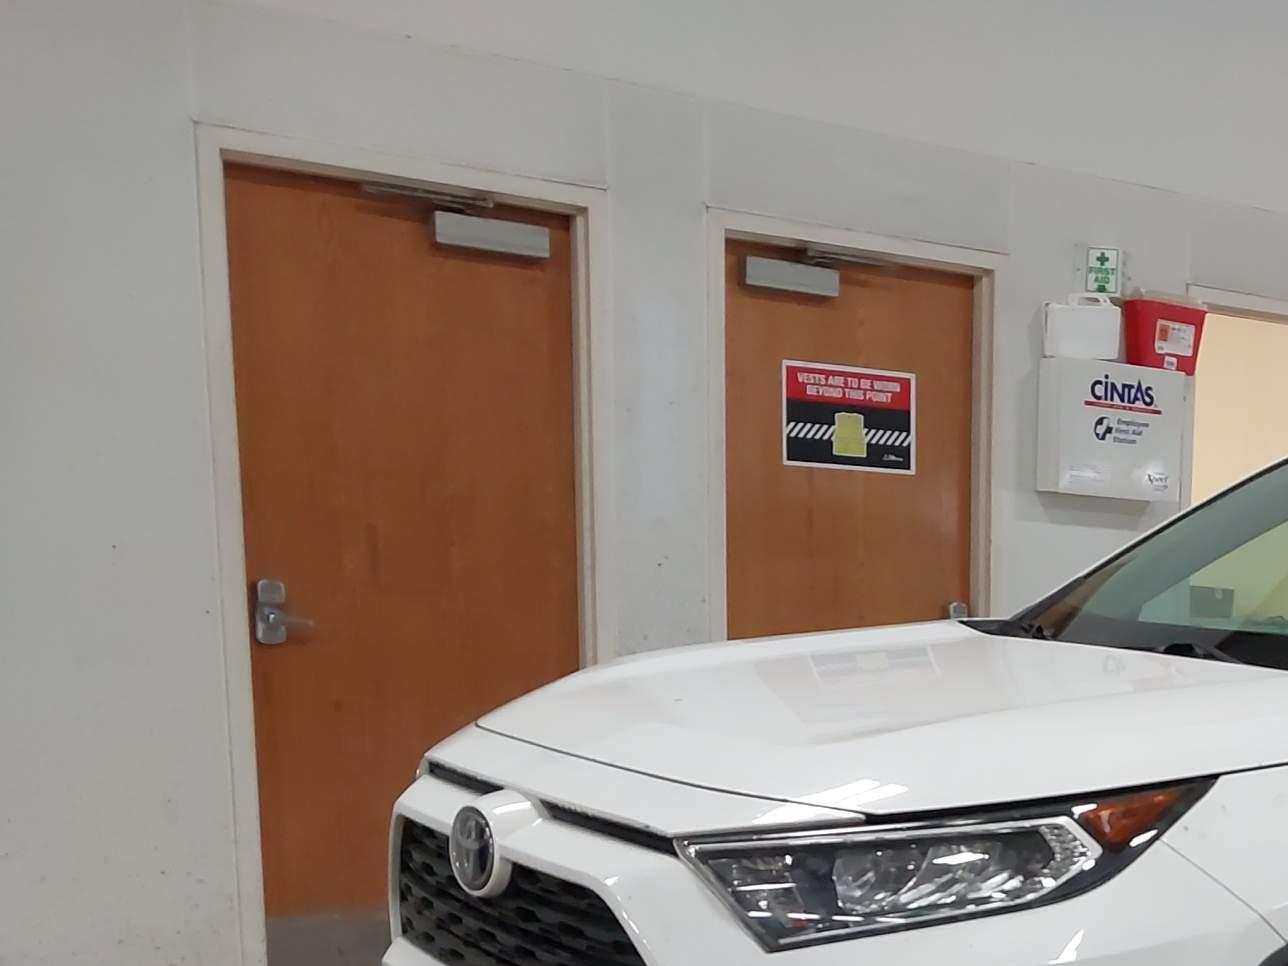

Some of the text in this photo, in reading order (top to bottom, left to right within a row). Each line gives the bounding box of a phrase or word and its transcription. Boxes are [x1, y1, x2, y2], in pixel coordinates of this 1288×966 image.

[1088, 266, 1116, 276] FIRST
[1094, 275, 1110, 285] AID
[797, 372, 901, 392] VESTS ARE TO BE WORN
[806, 384, 892, 403] BEYOND THIS POINT
